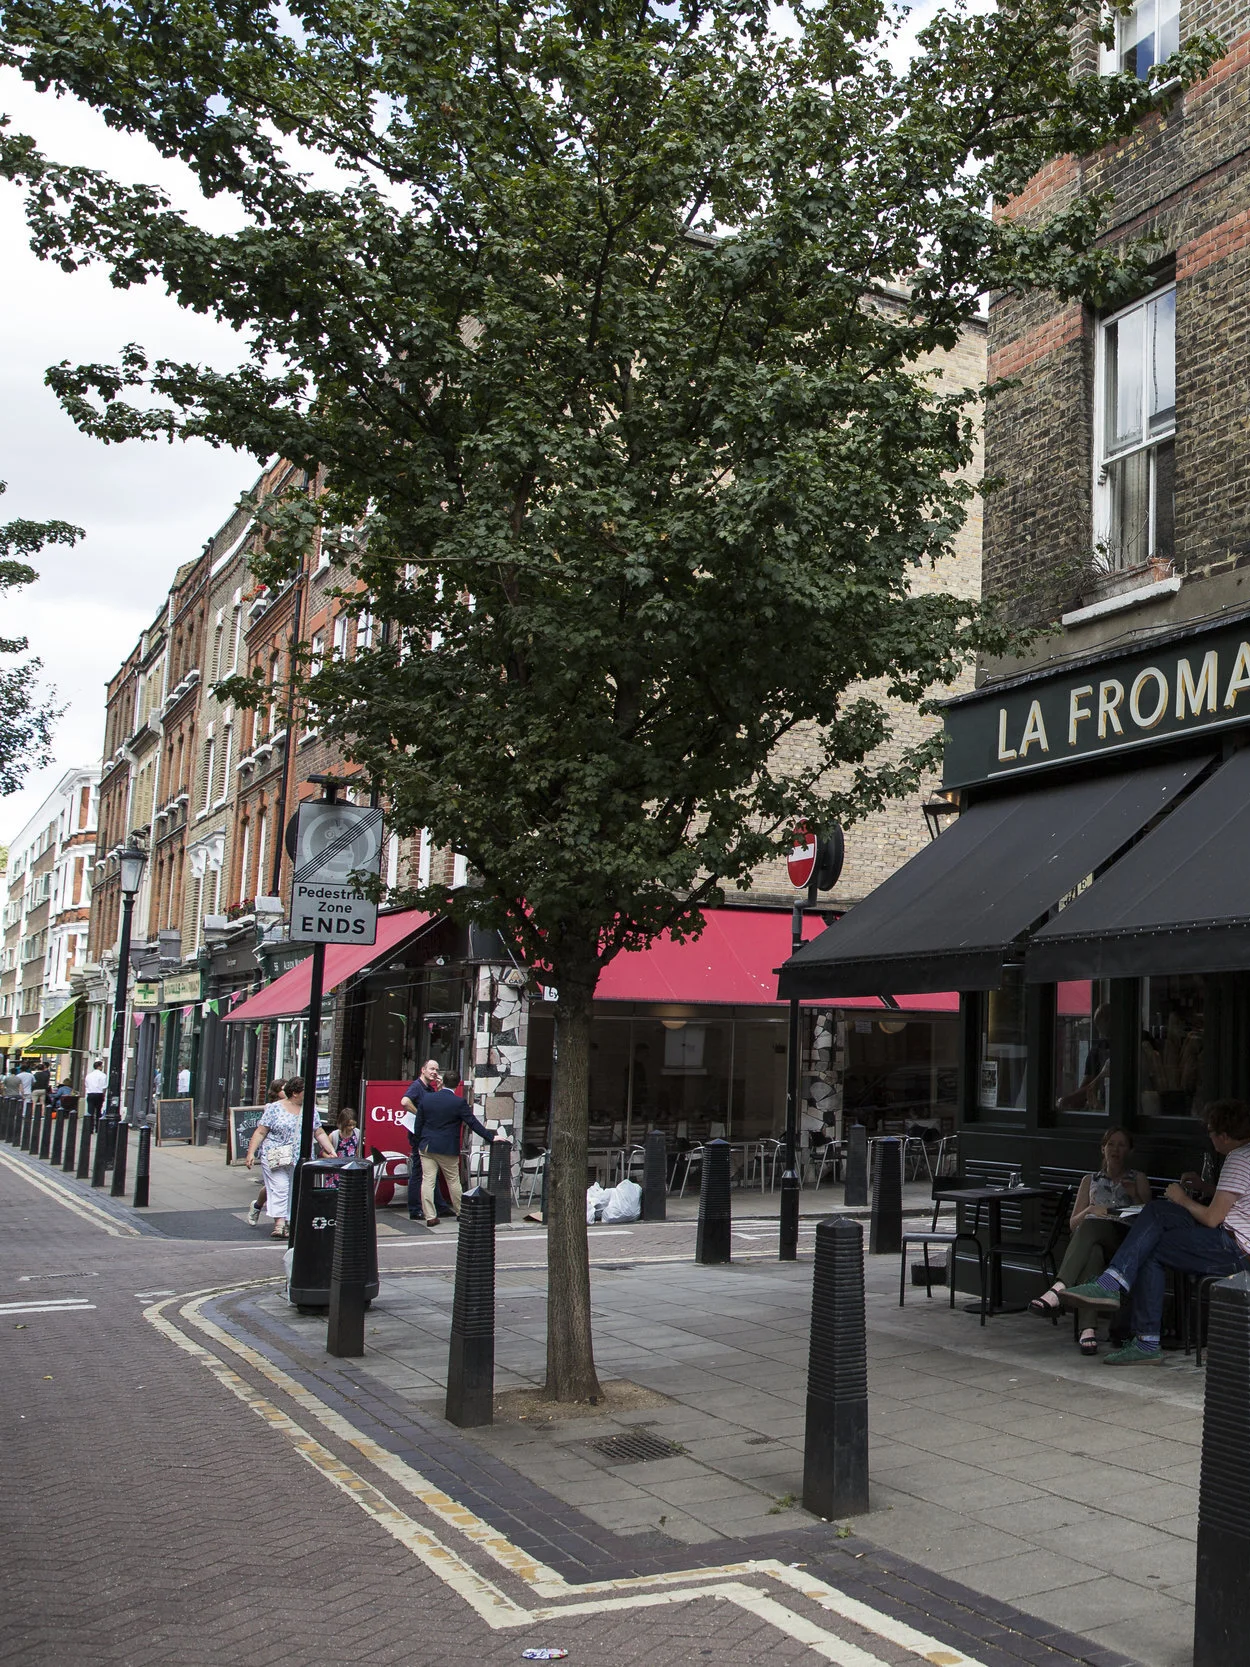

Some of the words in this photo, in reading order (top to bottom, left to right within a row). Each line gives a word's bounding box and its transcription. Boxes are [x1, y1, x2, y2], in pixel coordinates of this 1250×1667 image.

[997, 699, 1050, 762] LA
[298, 886, 371, 901] Pedestria
[317, 901, 353, 913] Zone
[301, 916, 366, 935] ENDS
[371, 1106, 406, 1126] Cig
